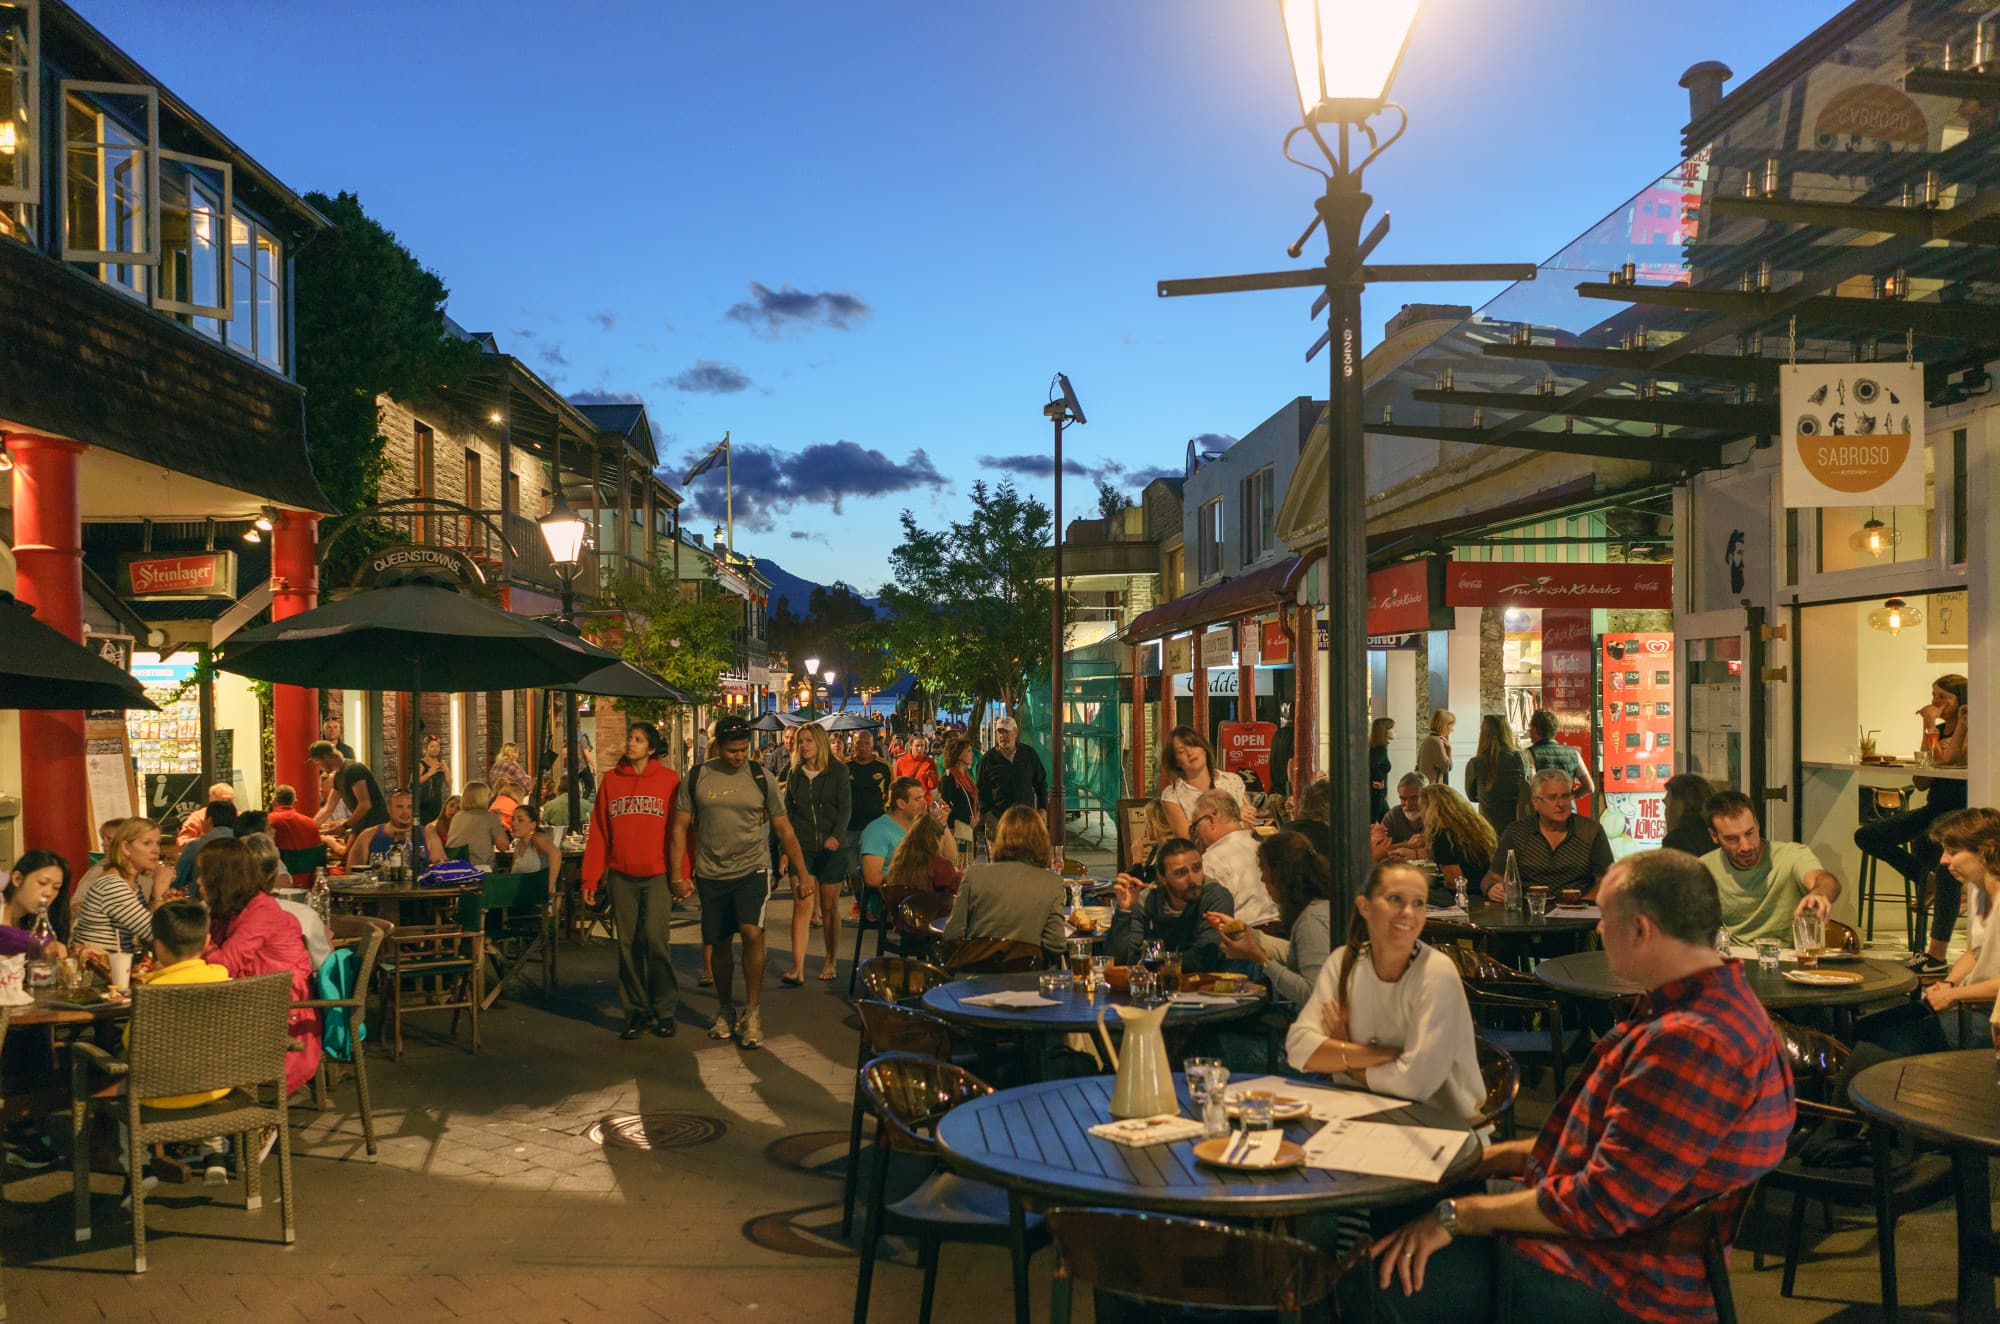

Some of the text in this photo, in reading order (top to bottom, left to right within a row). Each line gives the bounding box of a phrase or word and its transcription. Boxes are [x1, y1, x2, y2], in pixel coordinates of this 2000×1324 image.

[1818, 446, 1889, 466] SABROSO
[136, 561, 211, 589] Steinlager
[1568, 584, 1624, 596] Kebabs
[1233, 734, 1265, 746] OPEN
[608, 795, 665, 818] CORNELL
[1638, 798, 1661, 818] THE
[1633, 818, 1667, 839] LONGES
